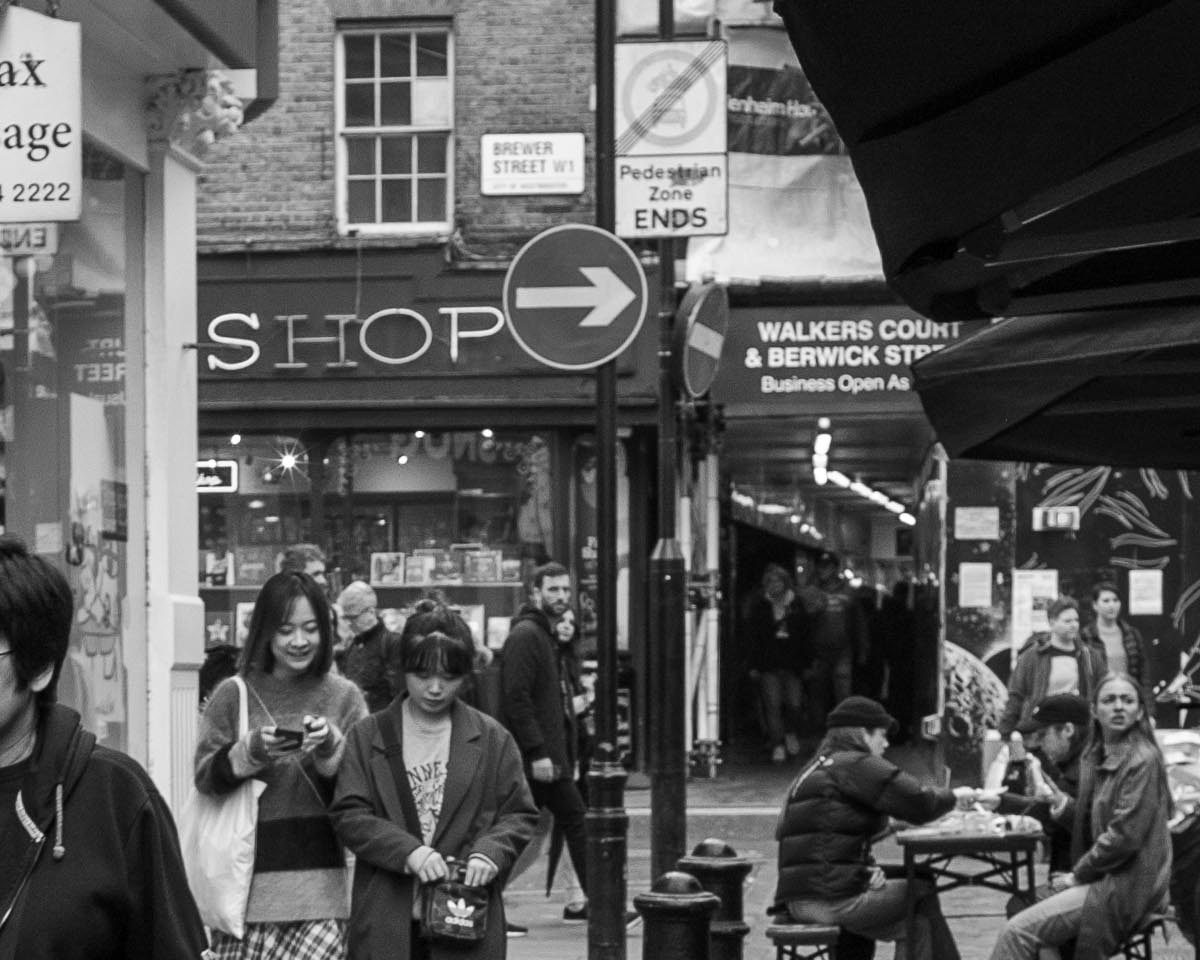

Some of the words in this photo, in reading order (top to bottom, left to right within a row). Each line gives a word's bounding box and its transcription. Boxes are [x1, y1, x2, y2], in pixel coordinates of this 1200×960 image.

[493, 141, 554, 156] BREWER
[493, 159, 546, 174] STREET
[553, 159, 575, 173] W1
[620, 163, 721, 180] Pedestrian
[12, 182, 71, 202] 2222
[649, 186, 693, 201] Zone
[635, 207, 707, 229] ENDS
[207, 305, 506, 370] SHOP
[757, 319, 874, 342] WALKERS
[878, 318, 961, 341] COURT
[744, 347, 763, 368] &
[767, 345, 880, 368] BERWICK
[760, 375, 836, 393] Business
[837, 374, 885, 395] Open
[886, 373, 911, 391] As
